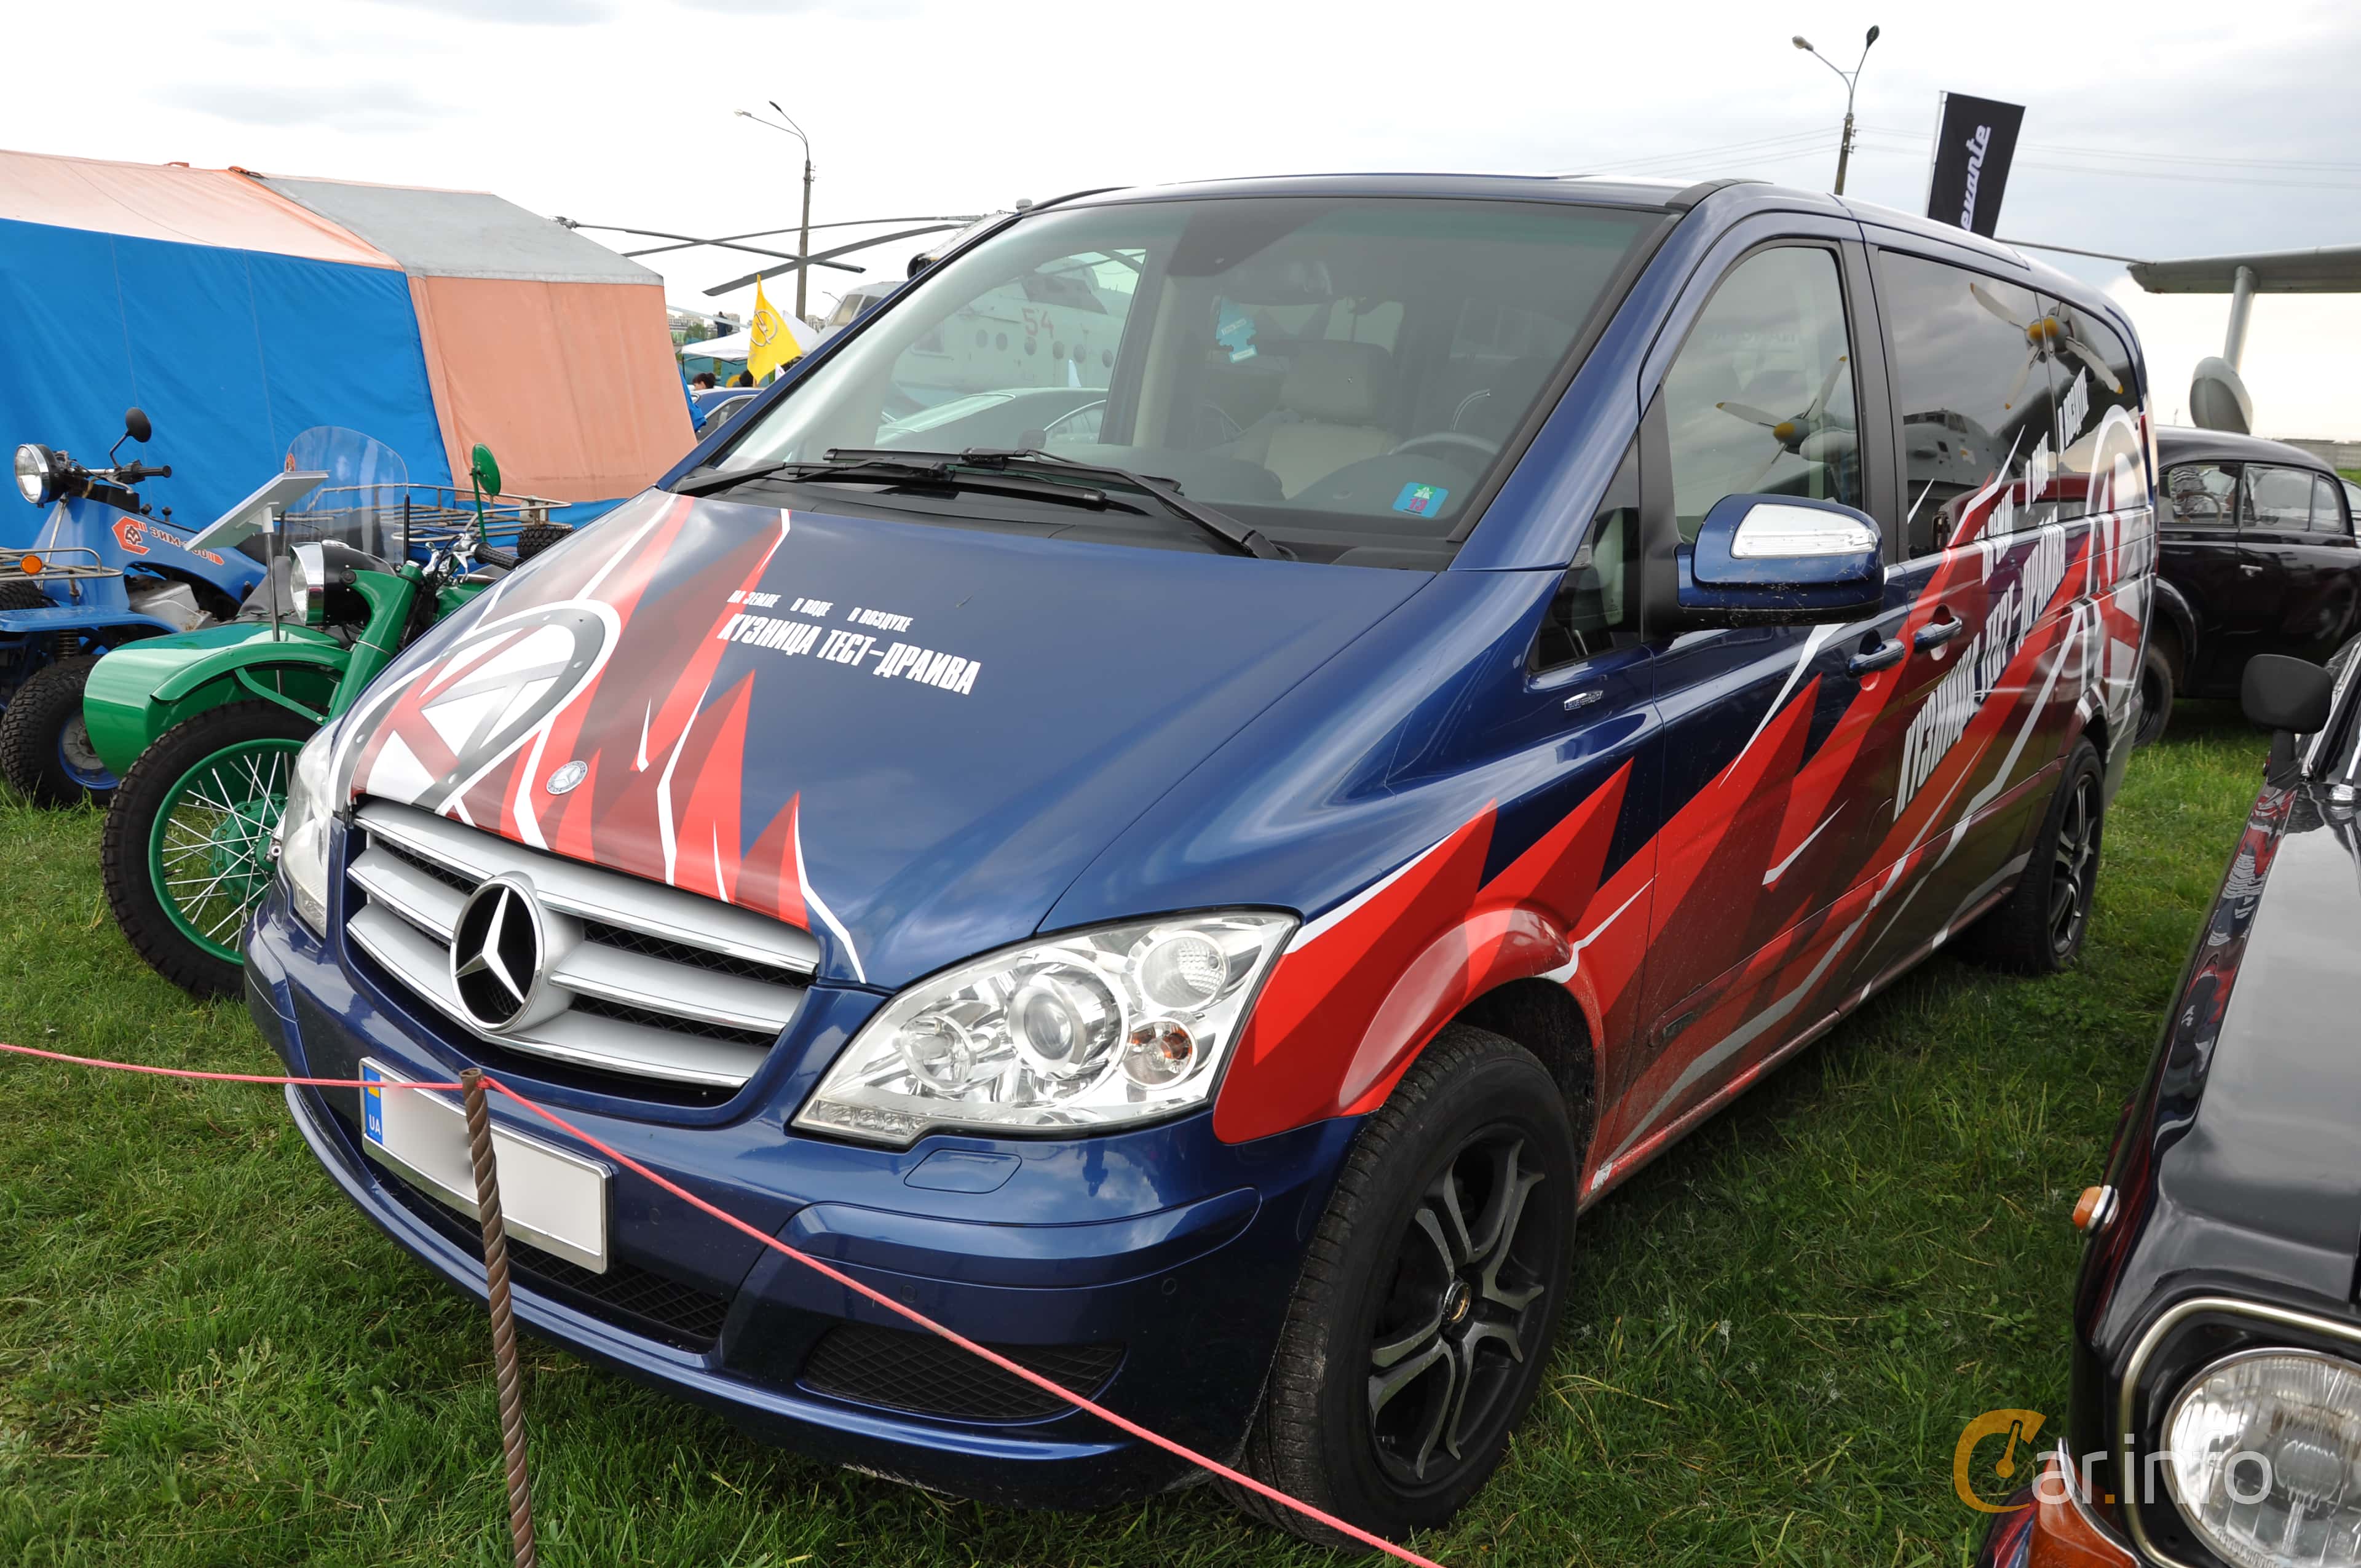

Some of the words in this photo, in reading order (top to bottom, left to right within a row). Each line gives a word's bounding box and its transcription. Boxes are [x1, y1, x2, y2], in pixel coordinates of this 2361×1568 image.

[1022, 307, 1054, 338] 54
[727, 590, 746, 603] НА
[743, 591, 781, 608] ЗЕМЛЕ
[789, 598, 804, 611] В
[800, 599, 833, 617] ВОДЕ
[847, 607, 861, 622] В
[858, 609, 914, 633] ВОЗДУХЕ
[716, 613, 823, 656] КУЗНИЦА
[369, 1114, 381, 1136] UA
